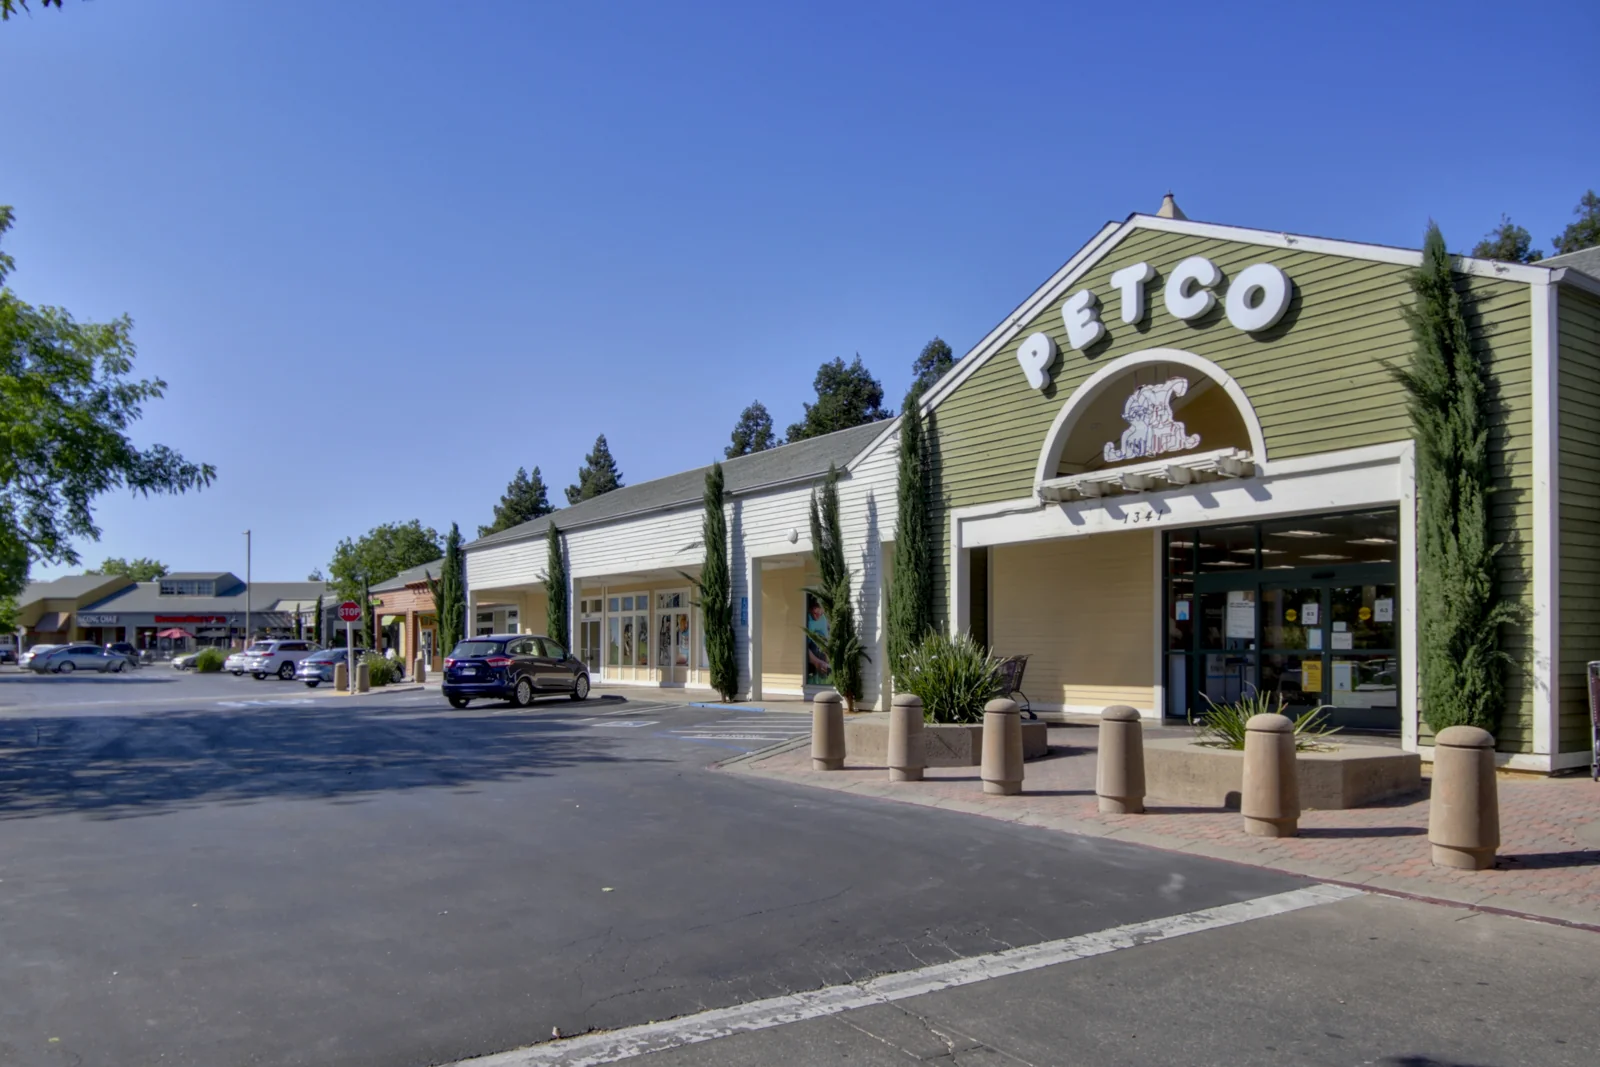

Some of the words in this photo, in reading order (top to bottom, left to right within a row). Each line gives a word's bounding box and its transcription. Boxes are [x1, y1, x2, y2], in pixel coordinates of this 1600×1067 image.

[1016, 255, 1293, 391] PETCO
[1124, 508, 1163, 524] 1341
[339, 607, 361, 616] STOP
